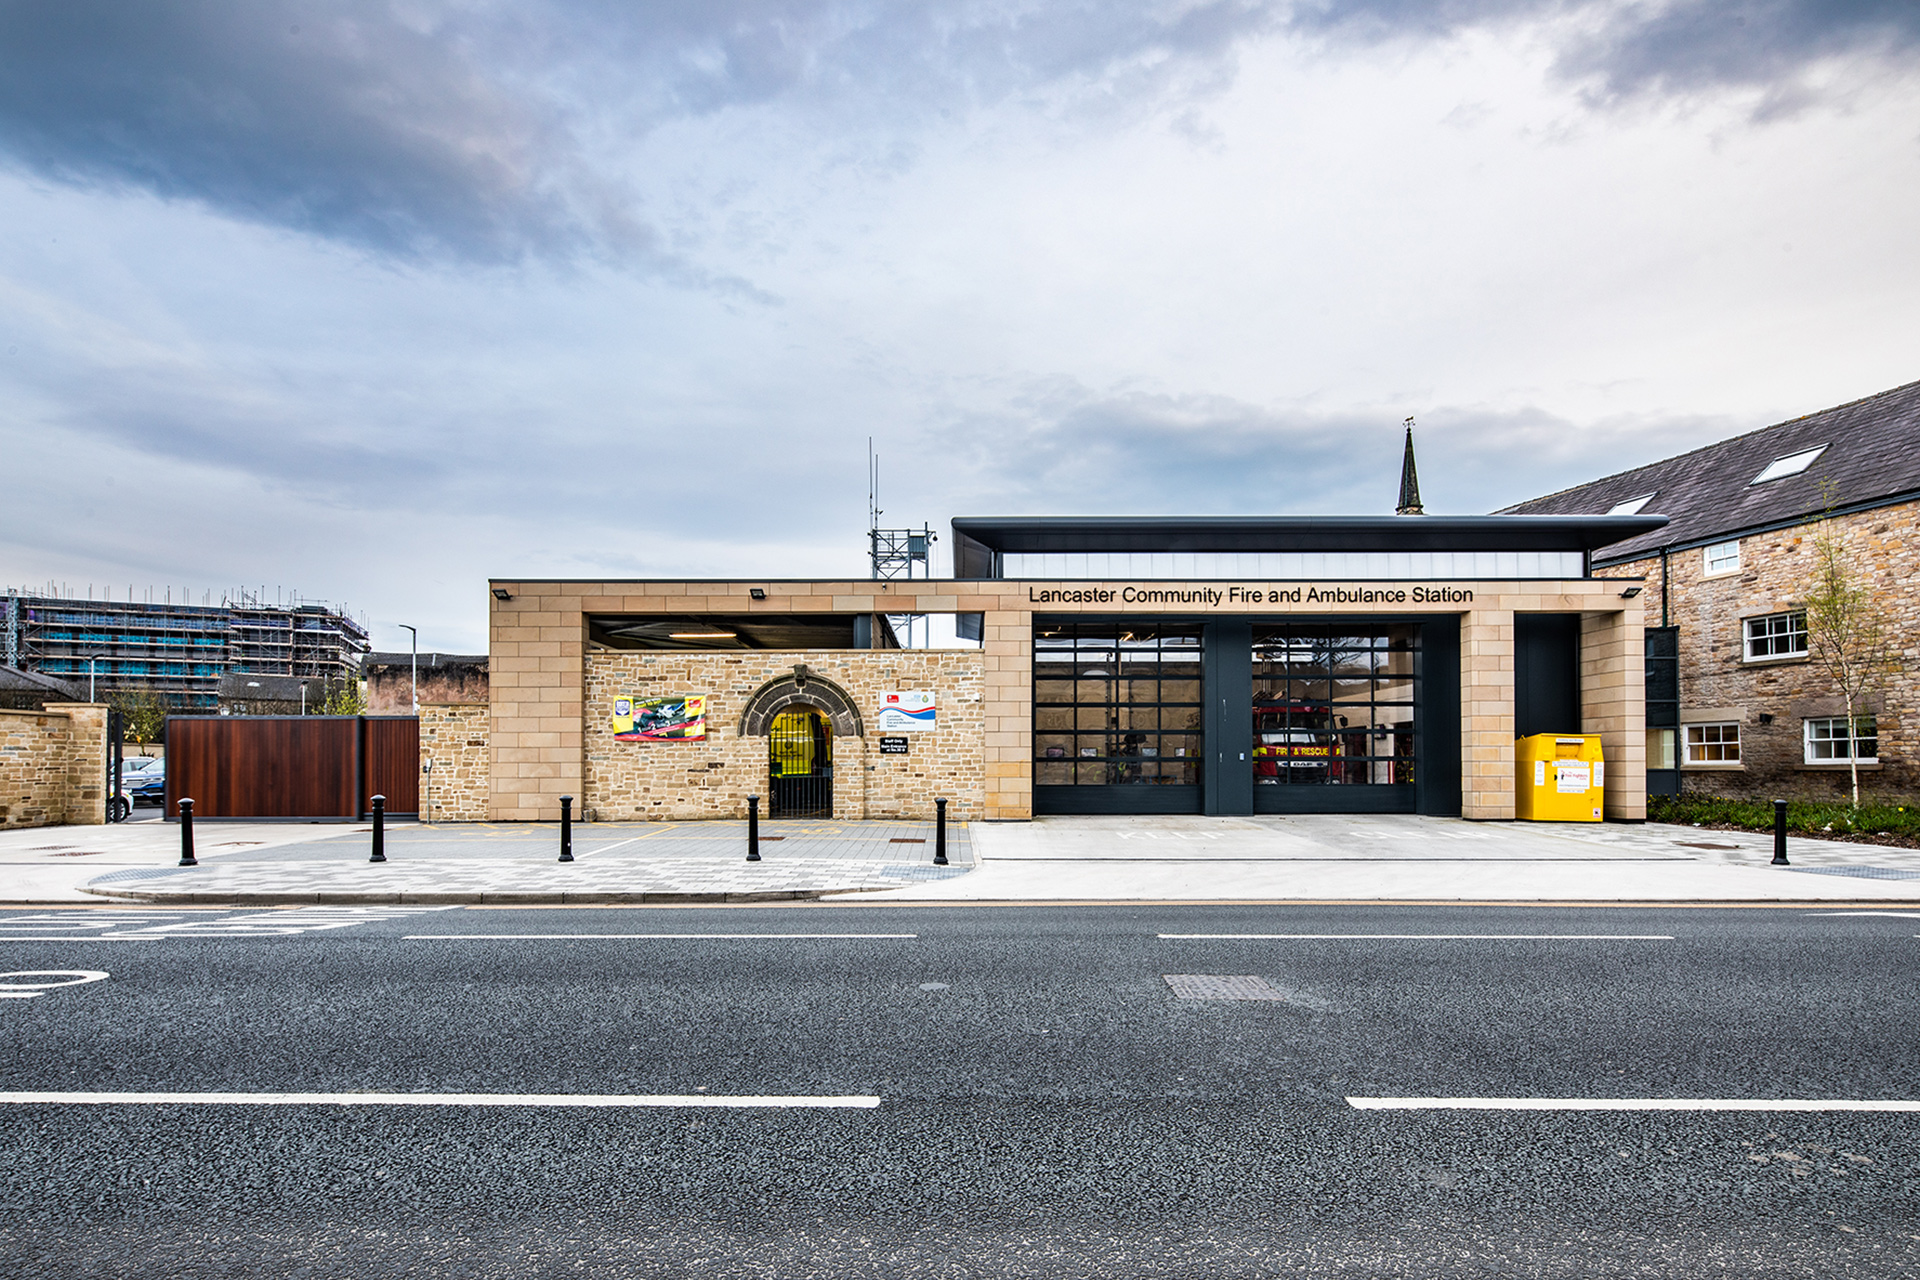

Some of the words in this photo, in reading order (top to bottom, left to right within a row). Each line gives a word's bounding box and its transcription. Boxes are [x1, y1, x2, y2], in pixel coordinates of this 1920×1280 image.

[1029, 586, 1117, 603] Lancaster
[1122, 586, 1223, 606] Community
[1229, 586, 1263, 603] Fire
[1268, 586, 1301, 603] and
[1306, 587, 1407, 603] Ambulance
[1412, 586, 1474, 603] Station
[1276, 747, 1288, 755] FIR
[1293, 747, 1298, 755] &
[1301, 747, 1328, 755] RESCUE
[1115, 832, 1225, 840] KEEP
